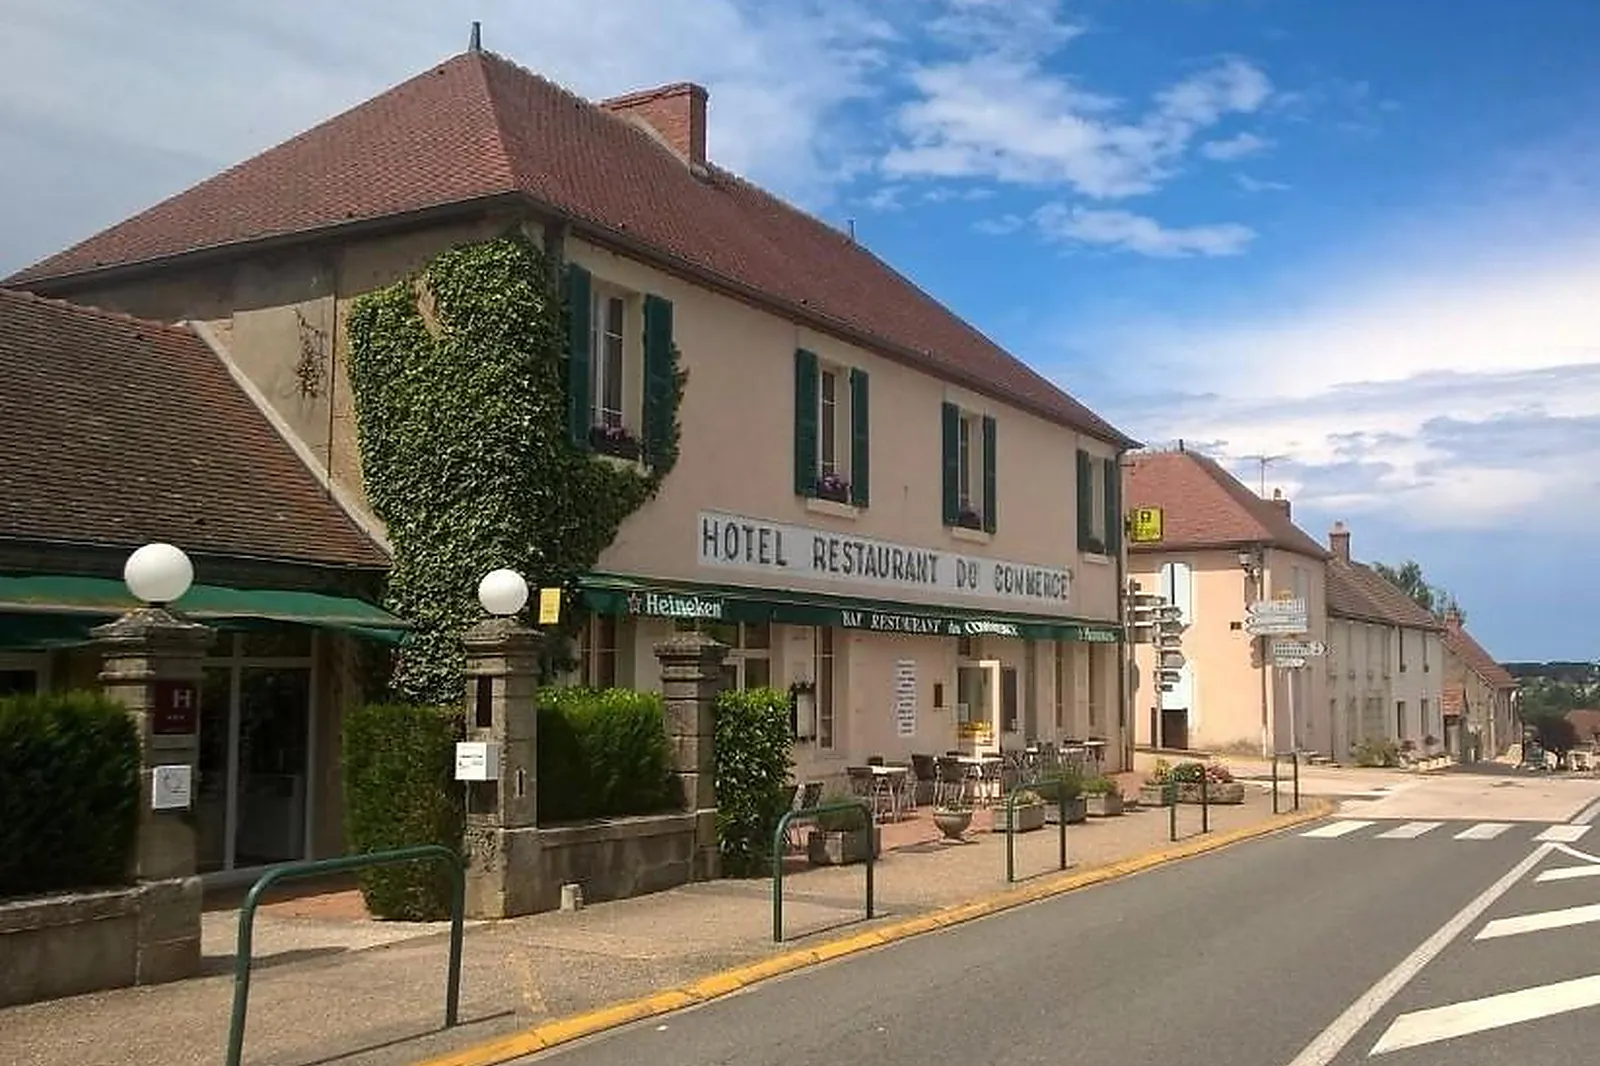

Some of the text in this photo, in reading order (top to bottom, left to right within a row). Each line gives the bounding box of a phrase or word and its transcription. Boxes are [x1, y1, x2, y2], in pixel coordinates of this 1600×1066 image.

[702, 518, 1070, 600] HOTEL RESTAURANT DU COMMERCE
[646, 592, 722, 619] Heineken
[173, 689, 191, 708] H
